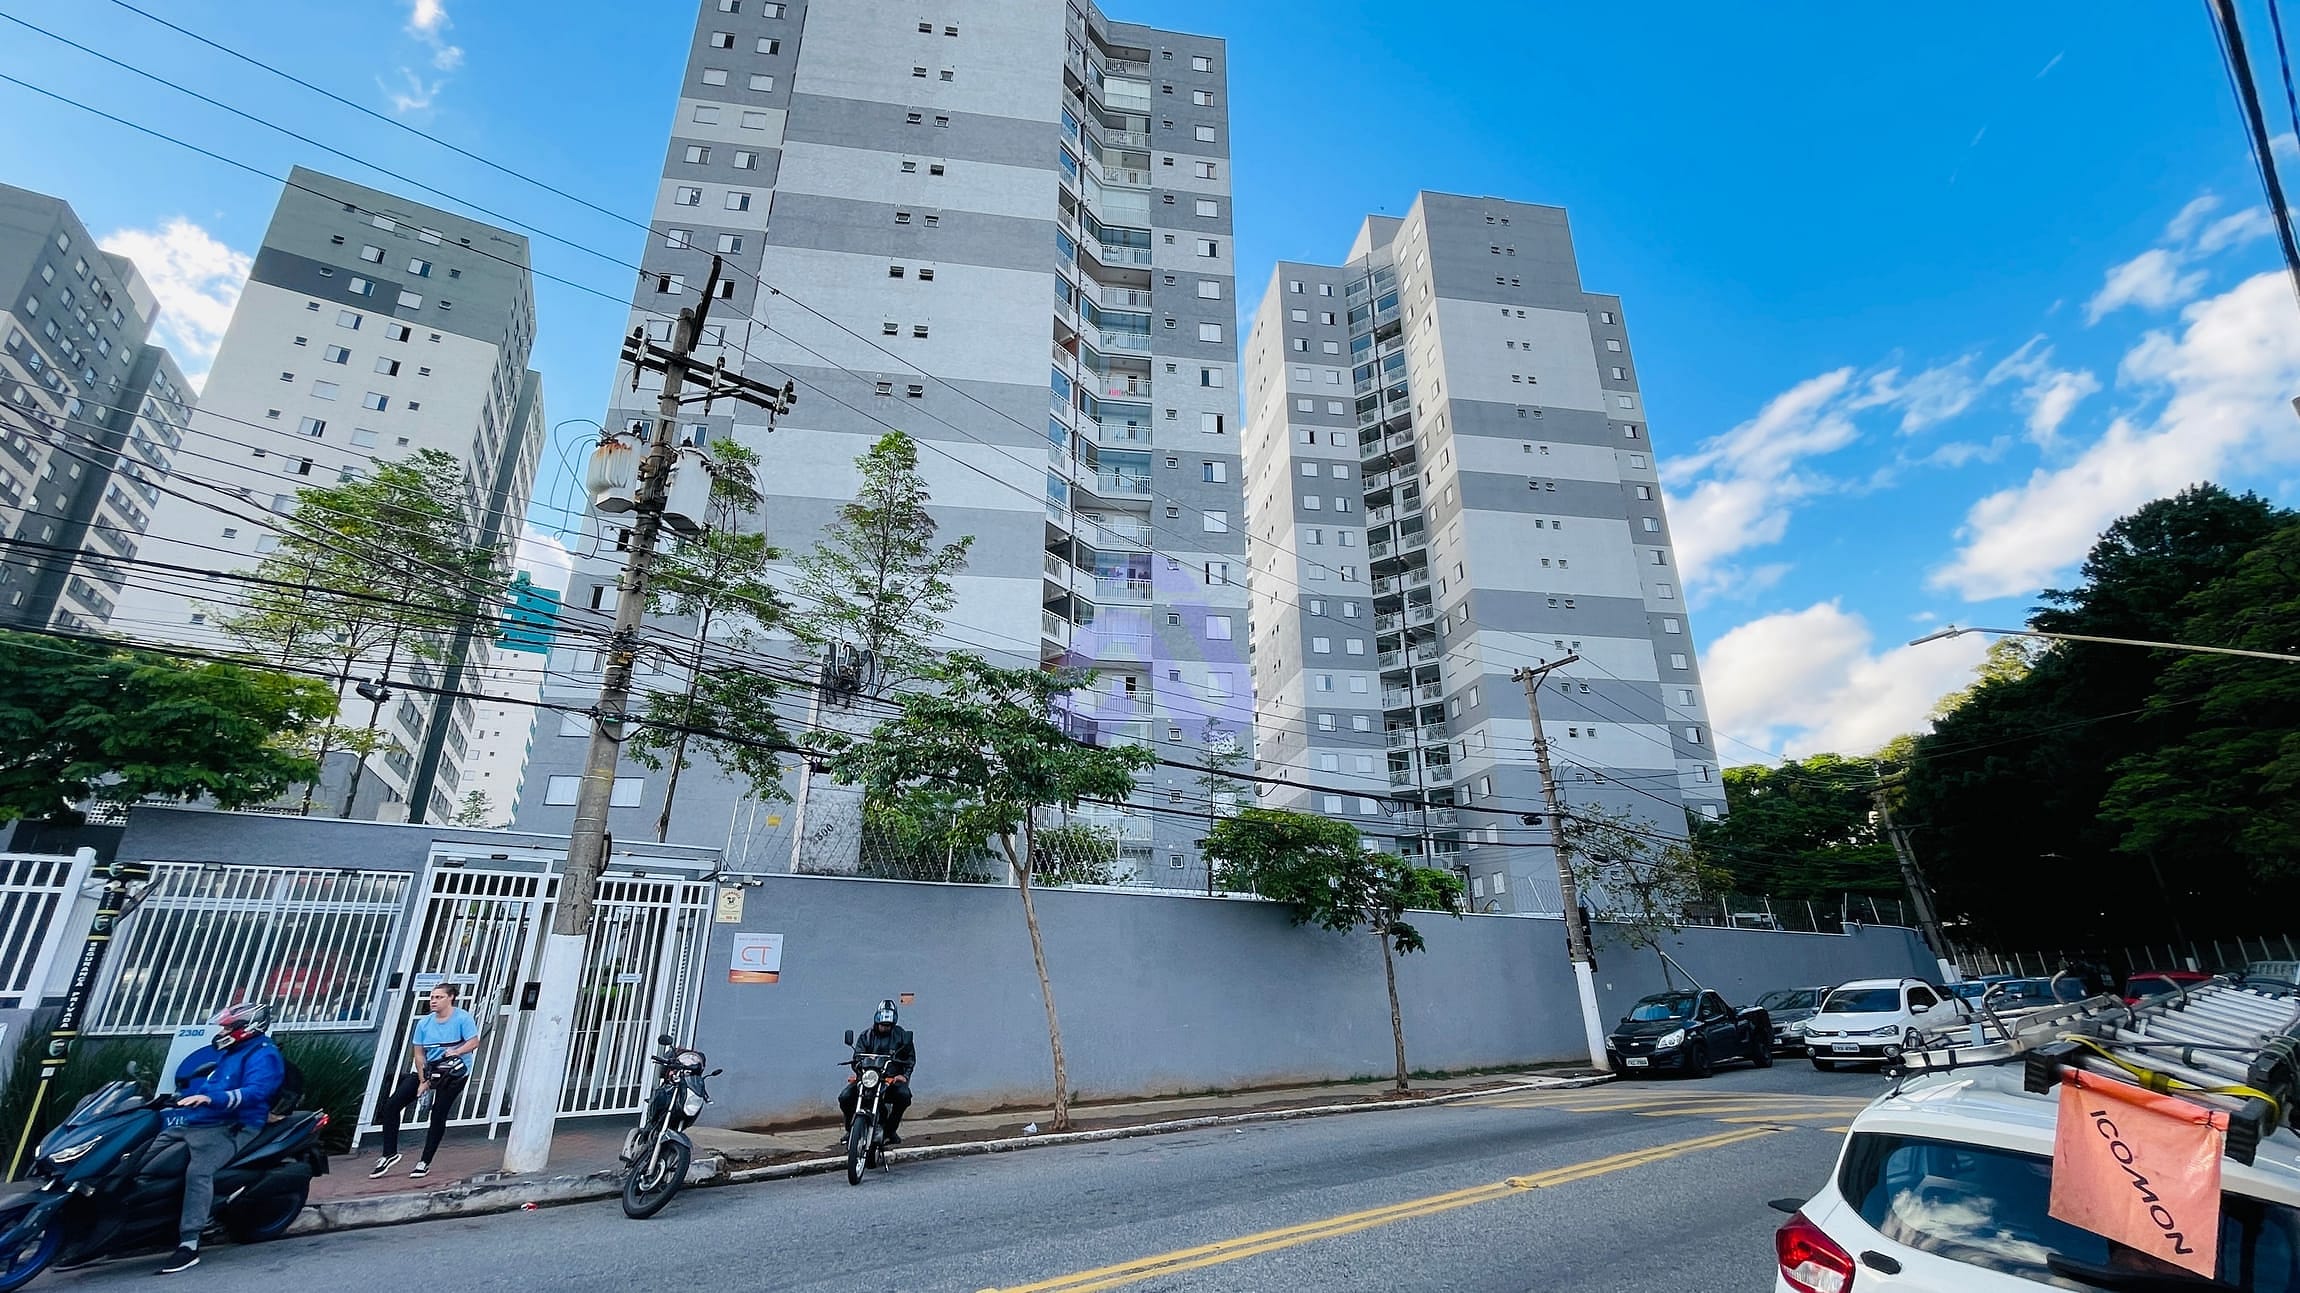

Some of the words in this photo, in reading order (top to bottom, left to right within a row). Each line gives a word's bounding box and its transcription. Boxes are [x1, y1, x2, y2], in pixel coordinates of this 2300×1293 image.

[60, 991, 80, 1028] PRIVADA
[178, 1029, 206, 1037] 2300
[2090, 1110, 2194, 1255] ICOMON
